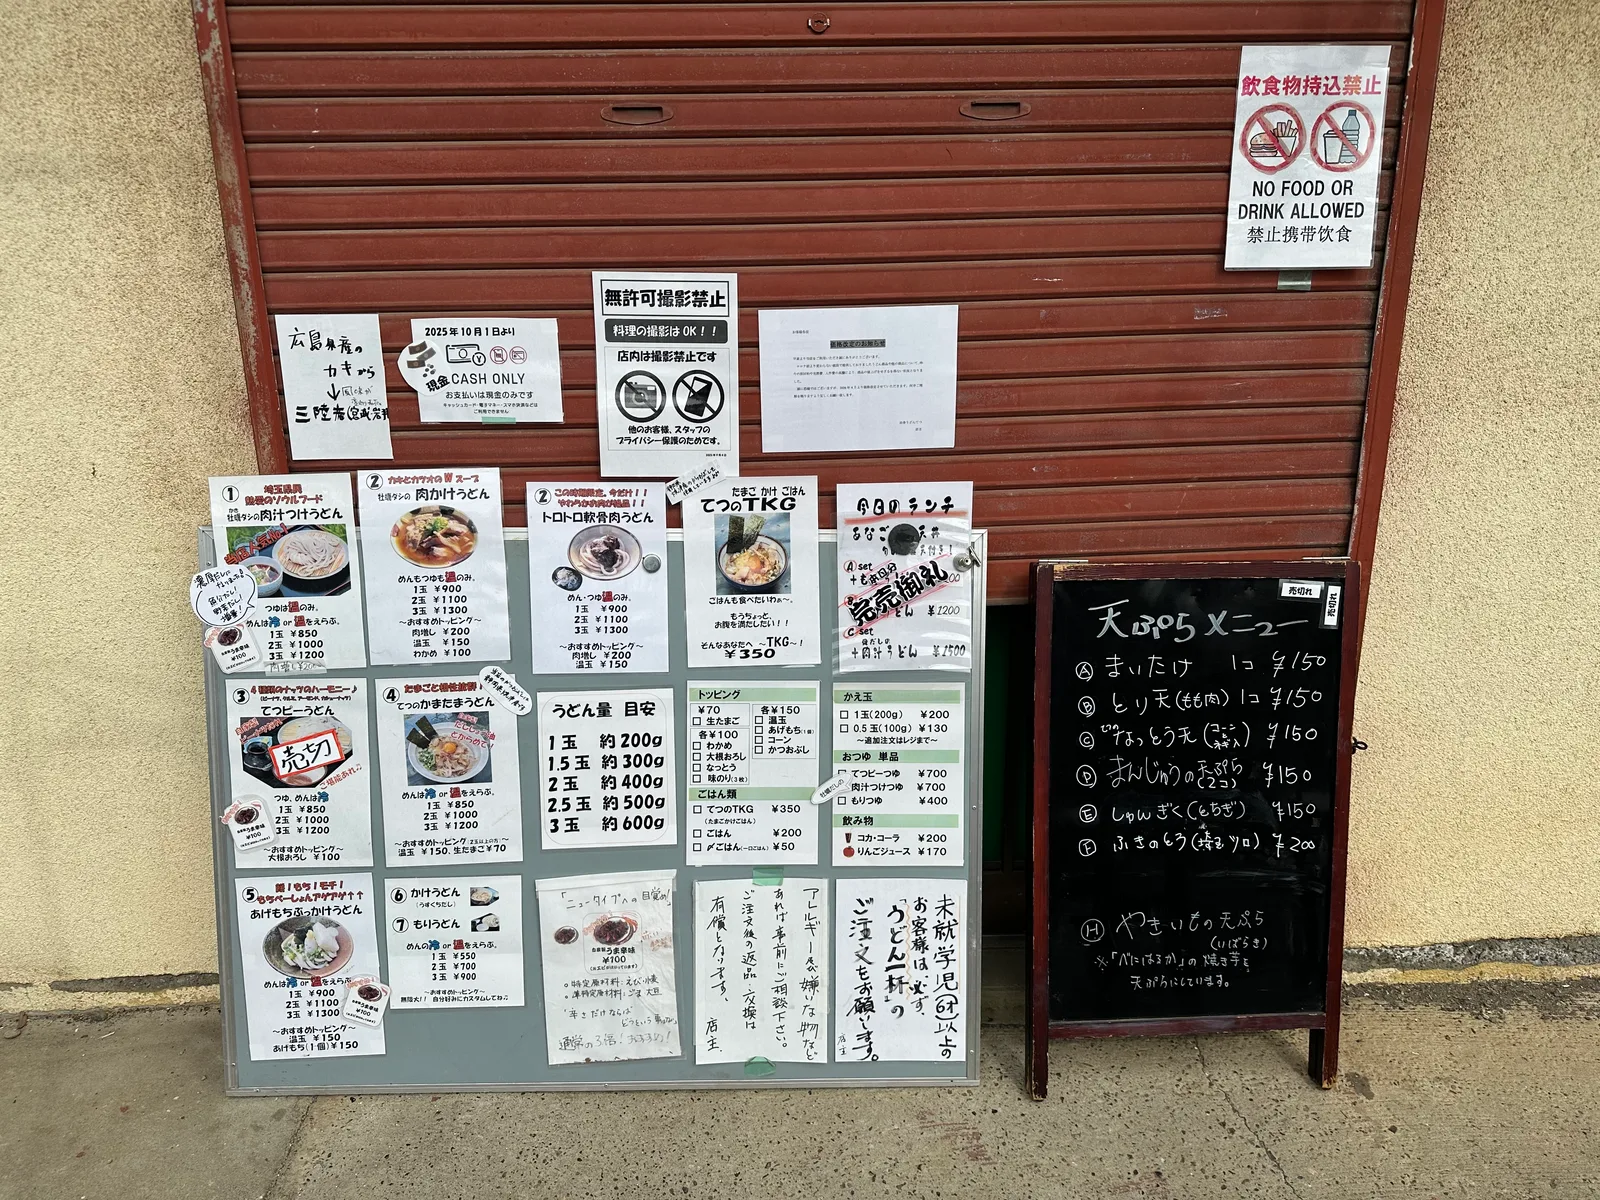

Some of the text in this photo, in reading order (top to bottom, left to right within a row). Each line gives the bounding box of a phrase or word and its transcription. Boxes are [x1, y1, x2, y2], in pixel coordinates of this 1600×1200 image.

[1241, 75, 1381, 96] 飲食物持込禁止
[1252, 180, 1353, 196] NO FOOD OR
[1238, 202, 1364, 219] DRINK ALLOWED
[1247, 225, 1353, 243] 禁止携带饮食
[605, 289, 726, 308] 無許可撮影禁止
[618, 351, 716, 362] 店内は撮影禁止です
[426, 375, 450, 392] 現金
[452, 373, 525, 385] CASH ONLY
[628, 425, 710, 434] 他のお客様、スタッフの
[616, 437, 720, 445] プライバシー保護のためです。
[416, 488, 489, 500] 肉かけうどん
[732, 487, 805, 497] たまご かけ ごはん
[701, 497, 796, 512] てつのTKG
[543, 512, 653, 523] トロトロ軟骨肉うどん
[849, 560, 948, 626] 完売御礼
[1289, 586, 1312, 596] 売切れ
[433, 596, 467, 604] ¥1100
[1327, 593, 1337, 617] 売切れ
[412, 606, 468, 615] 3玉 ¥1300
[596, 615, 628, 623] ¥1100
[596, 626, 628, 634] ¥1300
[290, 640, 323, 648] ¥1000
[413, 638, 469, 647] 温玉 ¥150
[701, 641, 753, 649] そんなあなたへ
[269, 651, 324, 660] 3玉 ¥1200
[414, 649, 471, 658] わかめ ¥100
[572, 651, 631, 660] 肉増し ¥200
[725, 649, 775, 659] ¥350
[576, 660, 628, 669] 温玉 ¥150
[1105, 654, 1192, 678] まいたけ
[699, 690, 740, 699] トッピング
[844, 692, 872, 701] かえ玉
[397, 697, 494, 710] てつのかまたまうどん
[261, 706, 334, 716] てつピーうどん
[553, 701, 655, 718] うどん量 目安
[698, 706, 800, 714] ¥70 各¥150
[707, 717, 740, 725] 生たまご
[919, 724, 947, 732] ¥130
[699, 731, 738, 739] 各¥100
[707, 742, 732, 750] わかめ
[282, 739, 331, 772] 売切
[706, 746, 809, 761] 大根おろし かつおぶし
[843, 752, 898, 761] おつゆ 単品
[918, 769, 947, 778] ¥700
[852, 783, 945, 791] 肉汁つけつゆ ¥700
[698, 789, 737, 799] ごはん類
[852, 797, 948, 805] もりつゆ ¥400
[707, 805, 800, 813] てつのTKG ¥350
[296, 816, 329, 824] ¥1000
[843, 816, 873, 826] 飲み物
[707, 829, 801, 838] ごはん ¥200
[858, 834, 900, 842] コカ・コーラ
[773, 842, 795, 851] ¥50
[858, 848, 947, 856] りんごジュース ¥170
[411, 888, 460, 898] かけうどん
[251, 905, 362, 919] あげもちぶっかけうどん
[413, 920, 460, 929] もりうどん
[453, 952, 476, 960] ¥550
[307, 999, 339, 1007] ¥1100
[308, 1009, 339, 1017] ¥1300
